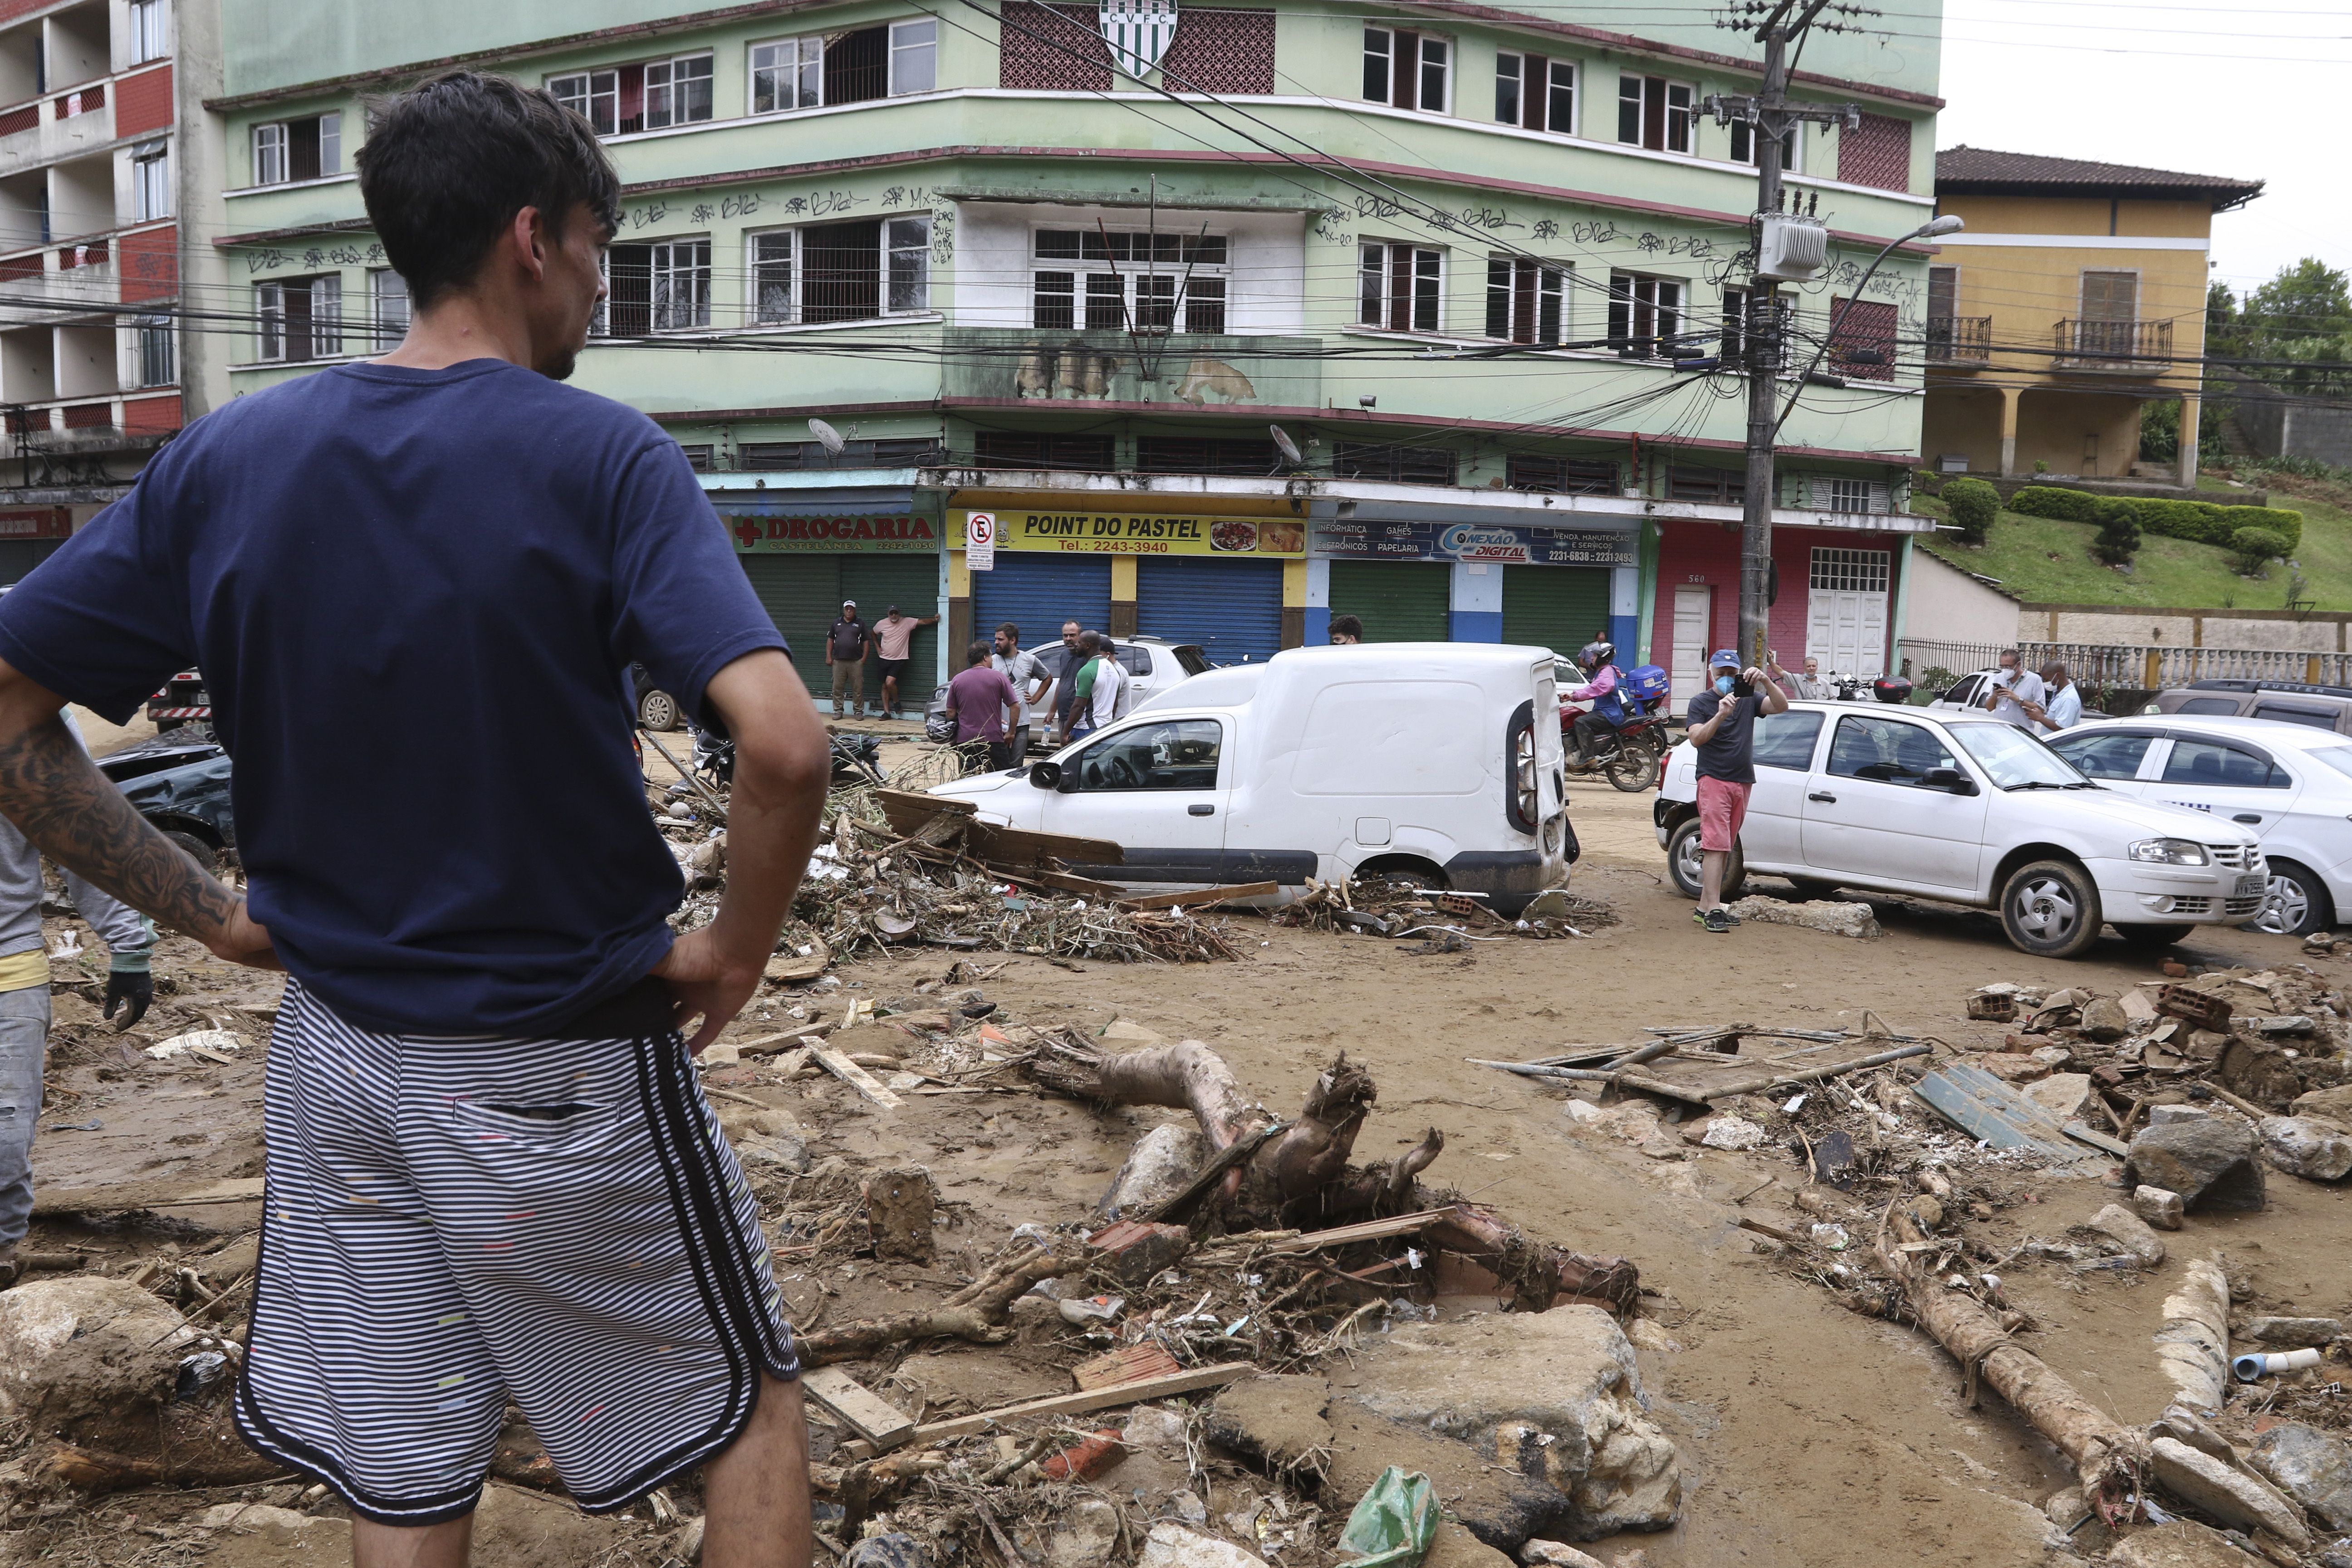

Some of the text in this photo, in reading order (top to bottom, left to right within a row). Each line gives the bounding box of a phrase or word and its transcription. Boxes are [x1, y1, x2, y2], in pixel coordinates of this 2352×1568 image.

[766, 518, 934, 540] DROGARIA
[1025, 515, 1201, 538] POINT DO PASTEL
[1318, 524, 1412, 535] INFORMÁTICA GAMES
[769, 541, 935, 550] CASTELÂNEA 2242-1050
[1058, 540, 1168, 552] Tel.: 2243-3940
[1378, 544, 1419, 553] PAPELARIA
[1475, 546, 1525, 557] DIGITAL
[1549, 550, 1589, 561] 2231-6838
[1596, 552, 1632, 563] 2231-2493
[1689, 574, 1705, 583] 560
[2261, 683, 2324, 693] DUSTER
